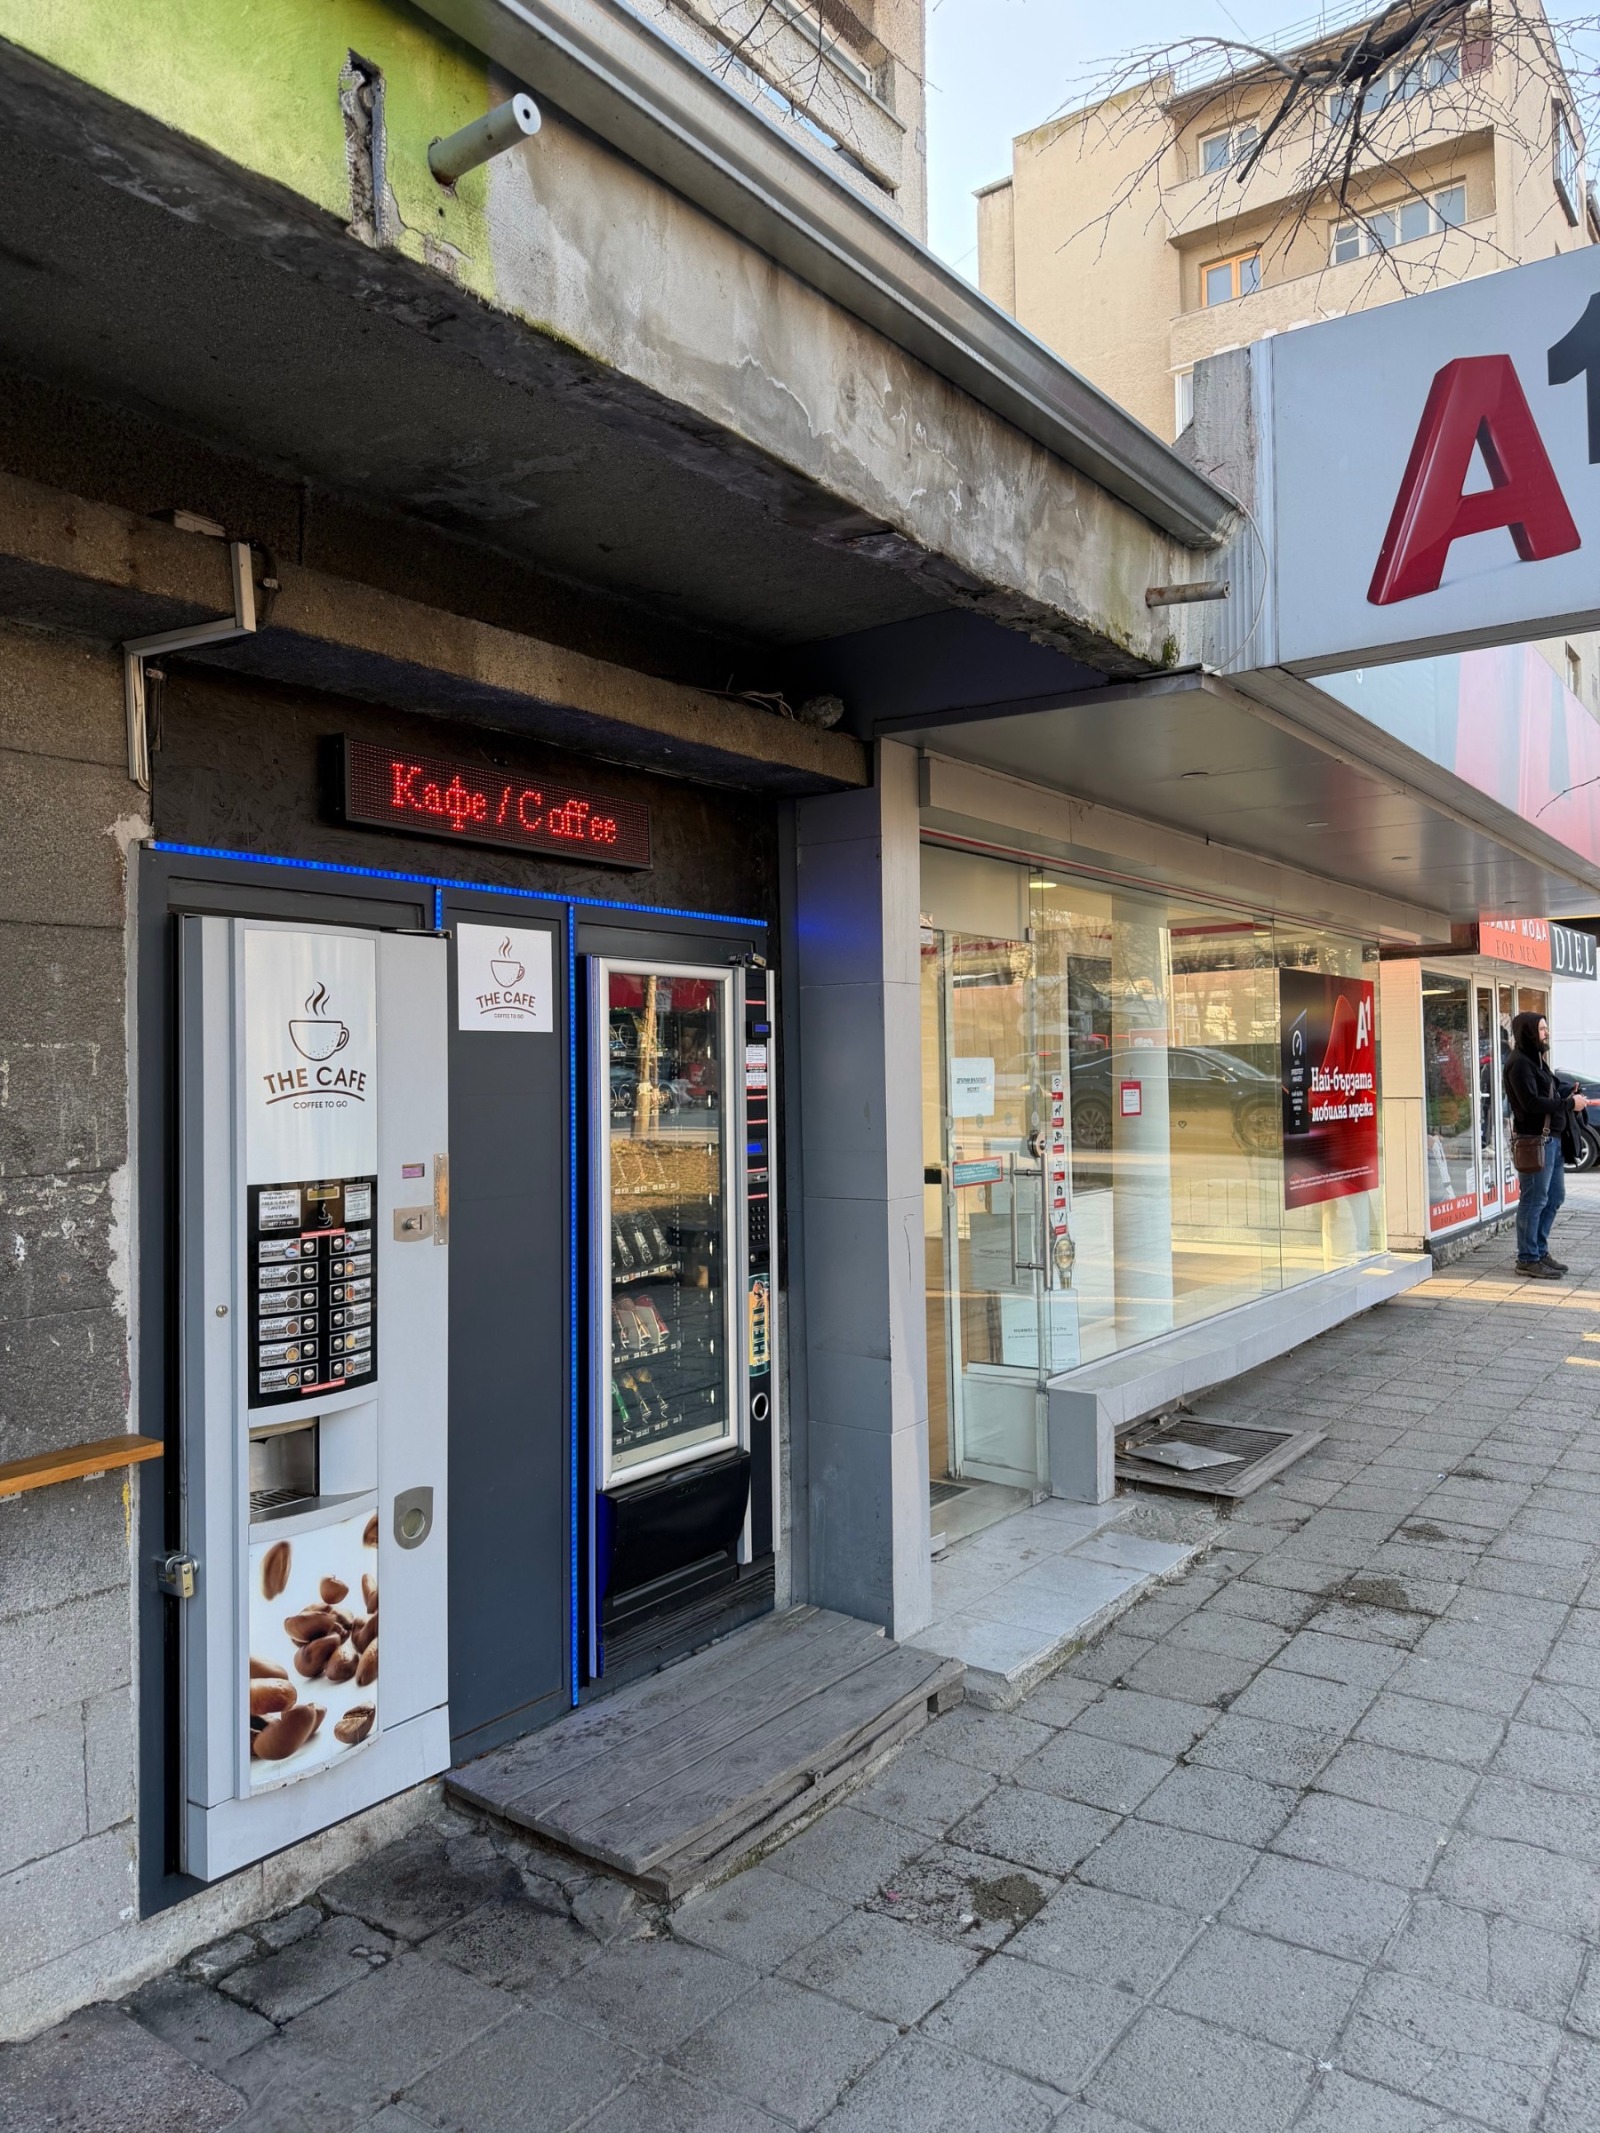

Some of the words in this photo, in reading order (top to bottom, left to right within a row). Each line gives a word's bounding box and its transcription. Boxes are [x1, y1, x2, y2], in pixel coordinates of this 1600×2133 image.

[1495, 939, 1515, 959] FOR
[1519, 945, 1538, 963] MEN
[1552, 926, 1594, 976] DIEL
[475, 991, 501, 1009] THE
[503, 991, 536, 1008] CAFE
[1356, 995, 1371, 1050] A1
[263, 1067, 309, 1095] THE
[316, 1066, 367, 1092] CAFE
[1311, 1066, 1373, 1097] Най-бързата
[293, 1100, 324, 1109] COFFEE
[324, 1100, 334, 1108] TO
[336, 1100, 348, 1108] GO
[1312, 1099, 1348, 1122] мобилна
[1348, 1097, 1374, 1123] мрежа
